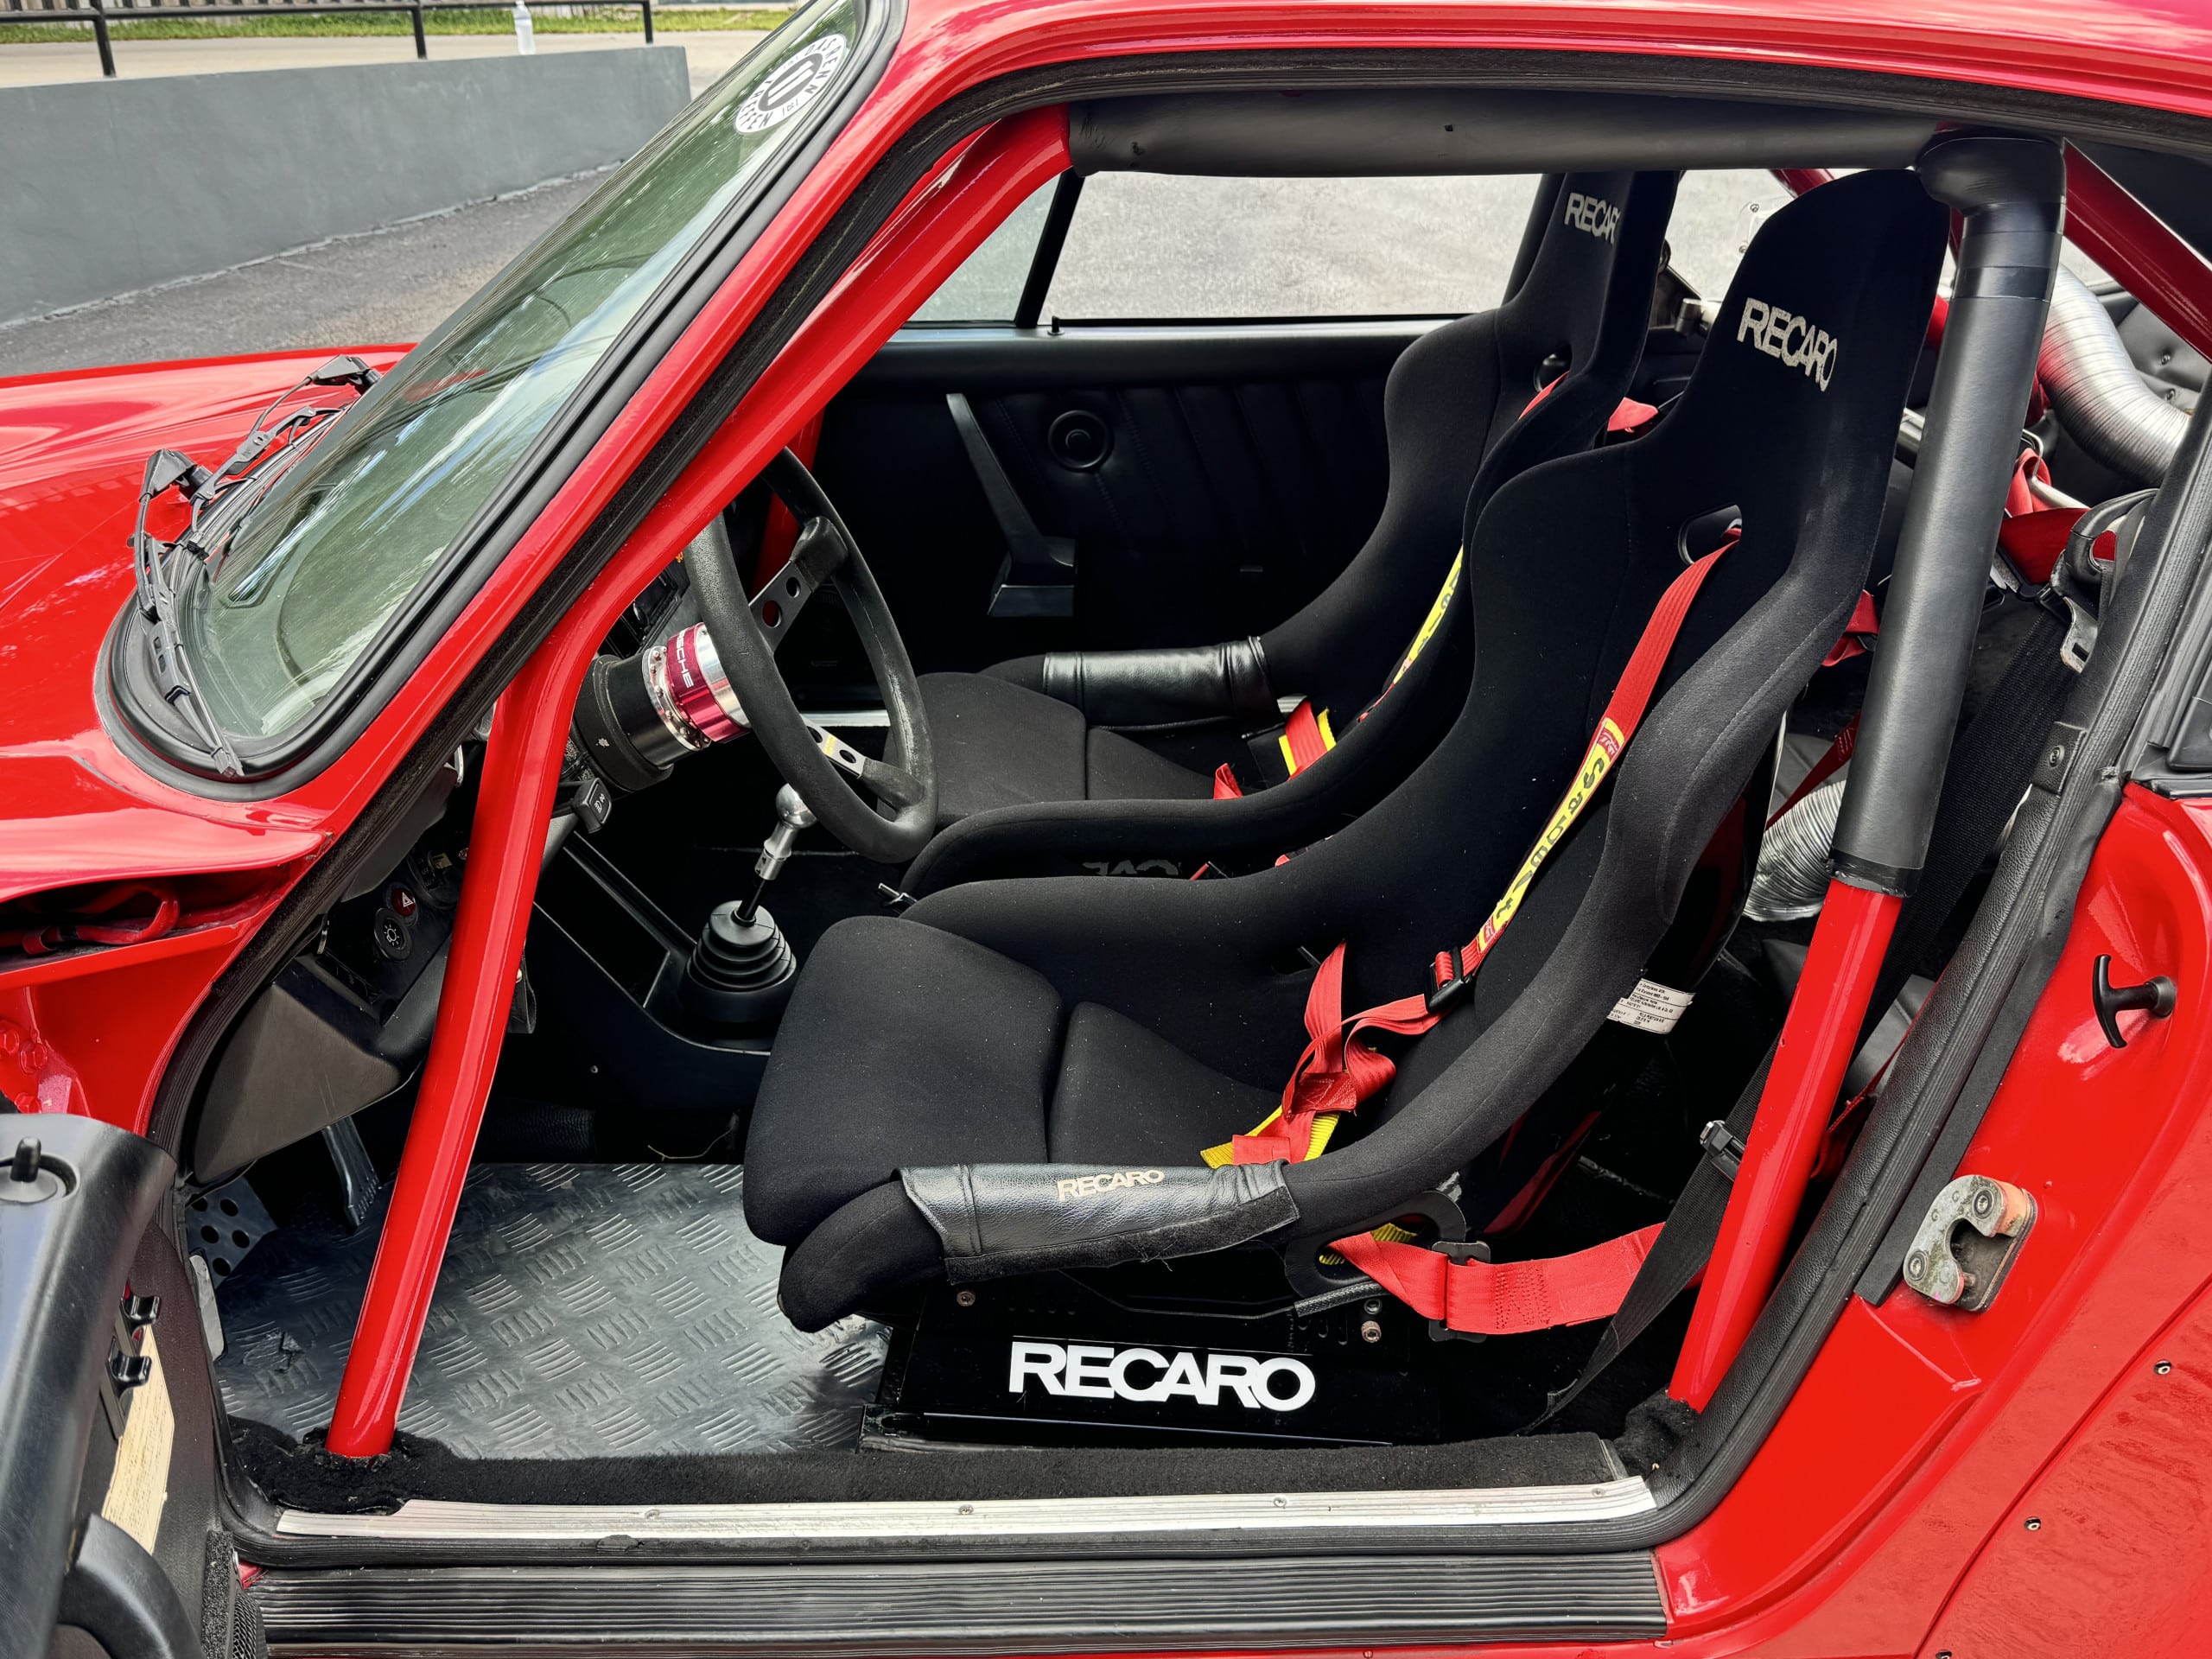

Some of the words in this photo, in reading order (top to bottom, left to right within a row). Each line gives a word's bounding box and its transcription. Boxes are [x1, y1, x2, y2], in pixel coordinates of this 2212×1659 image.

[1737, 297, 1838, 392] RECARO
[677, 629, 695, 689] RSCHE
[1057, 1169, 1165, 1202] RECARO
[1009, 1342, 1315, 1412] RECARO
